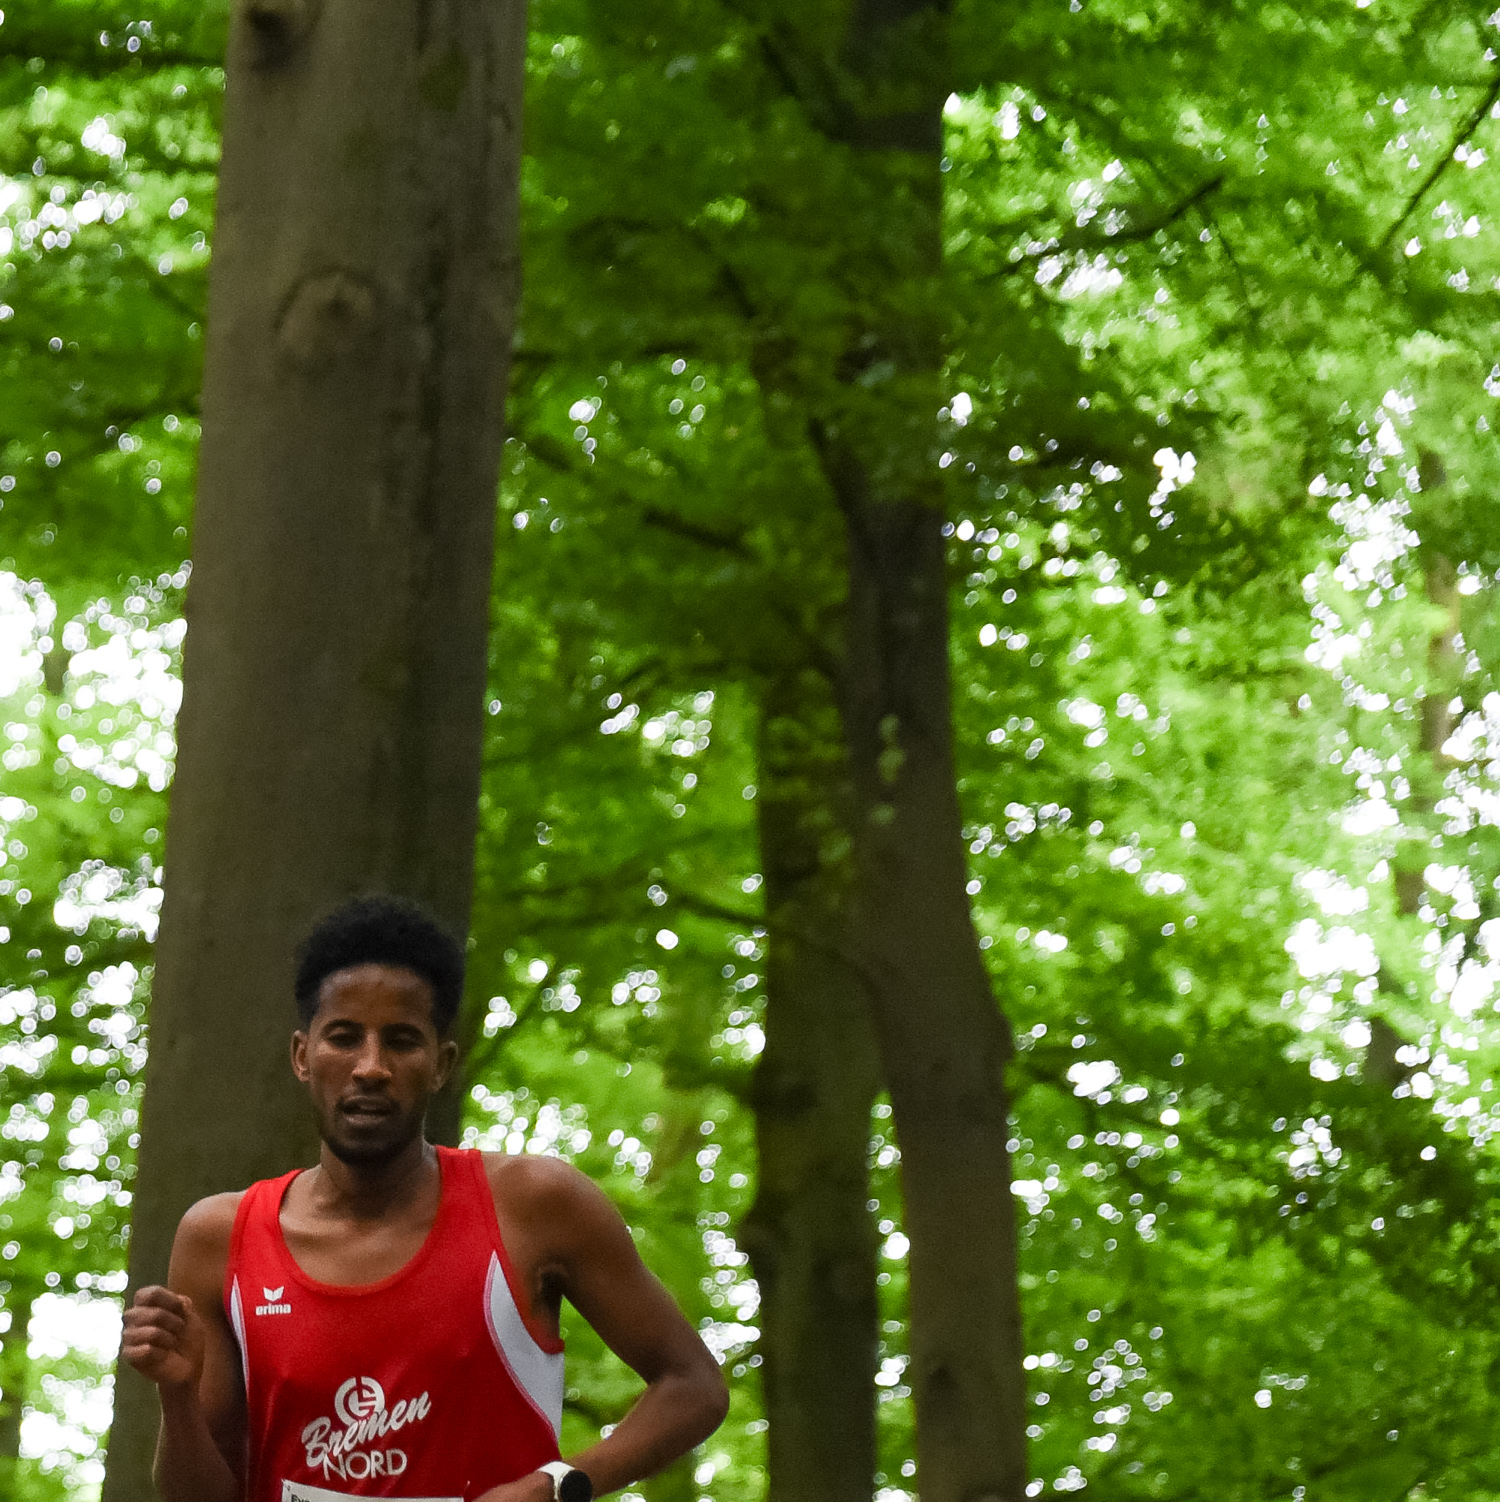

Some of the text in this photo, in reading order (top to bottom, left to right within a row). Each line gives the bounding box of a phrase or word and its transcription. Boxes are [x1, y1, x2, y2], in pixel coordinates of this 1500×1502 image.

[255, 1303, 292, 1316] erima
[300, 1390, 432, 1468] Bremen
[322, 1448, 408, 1481] NORD
